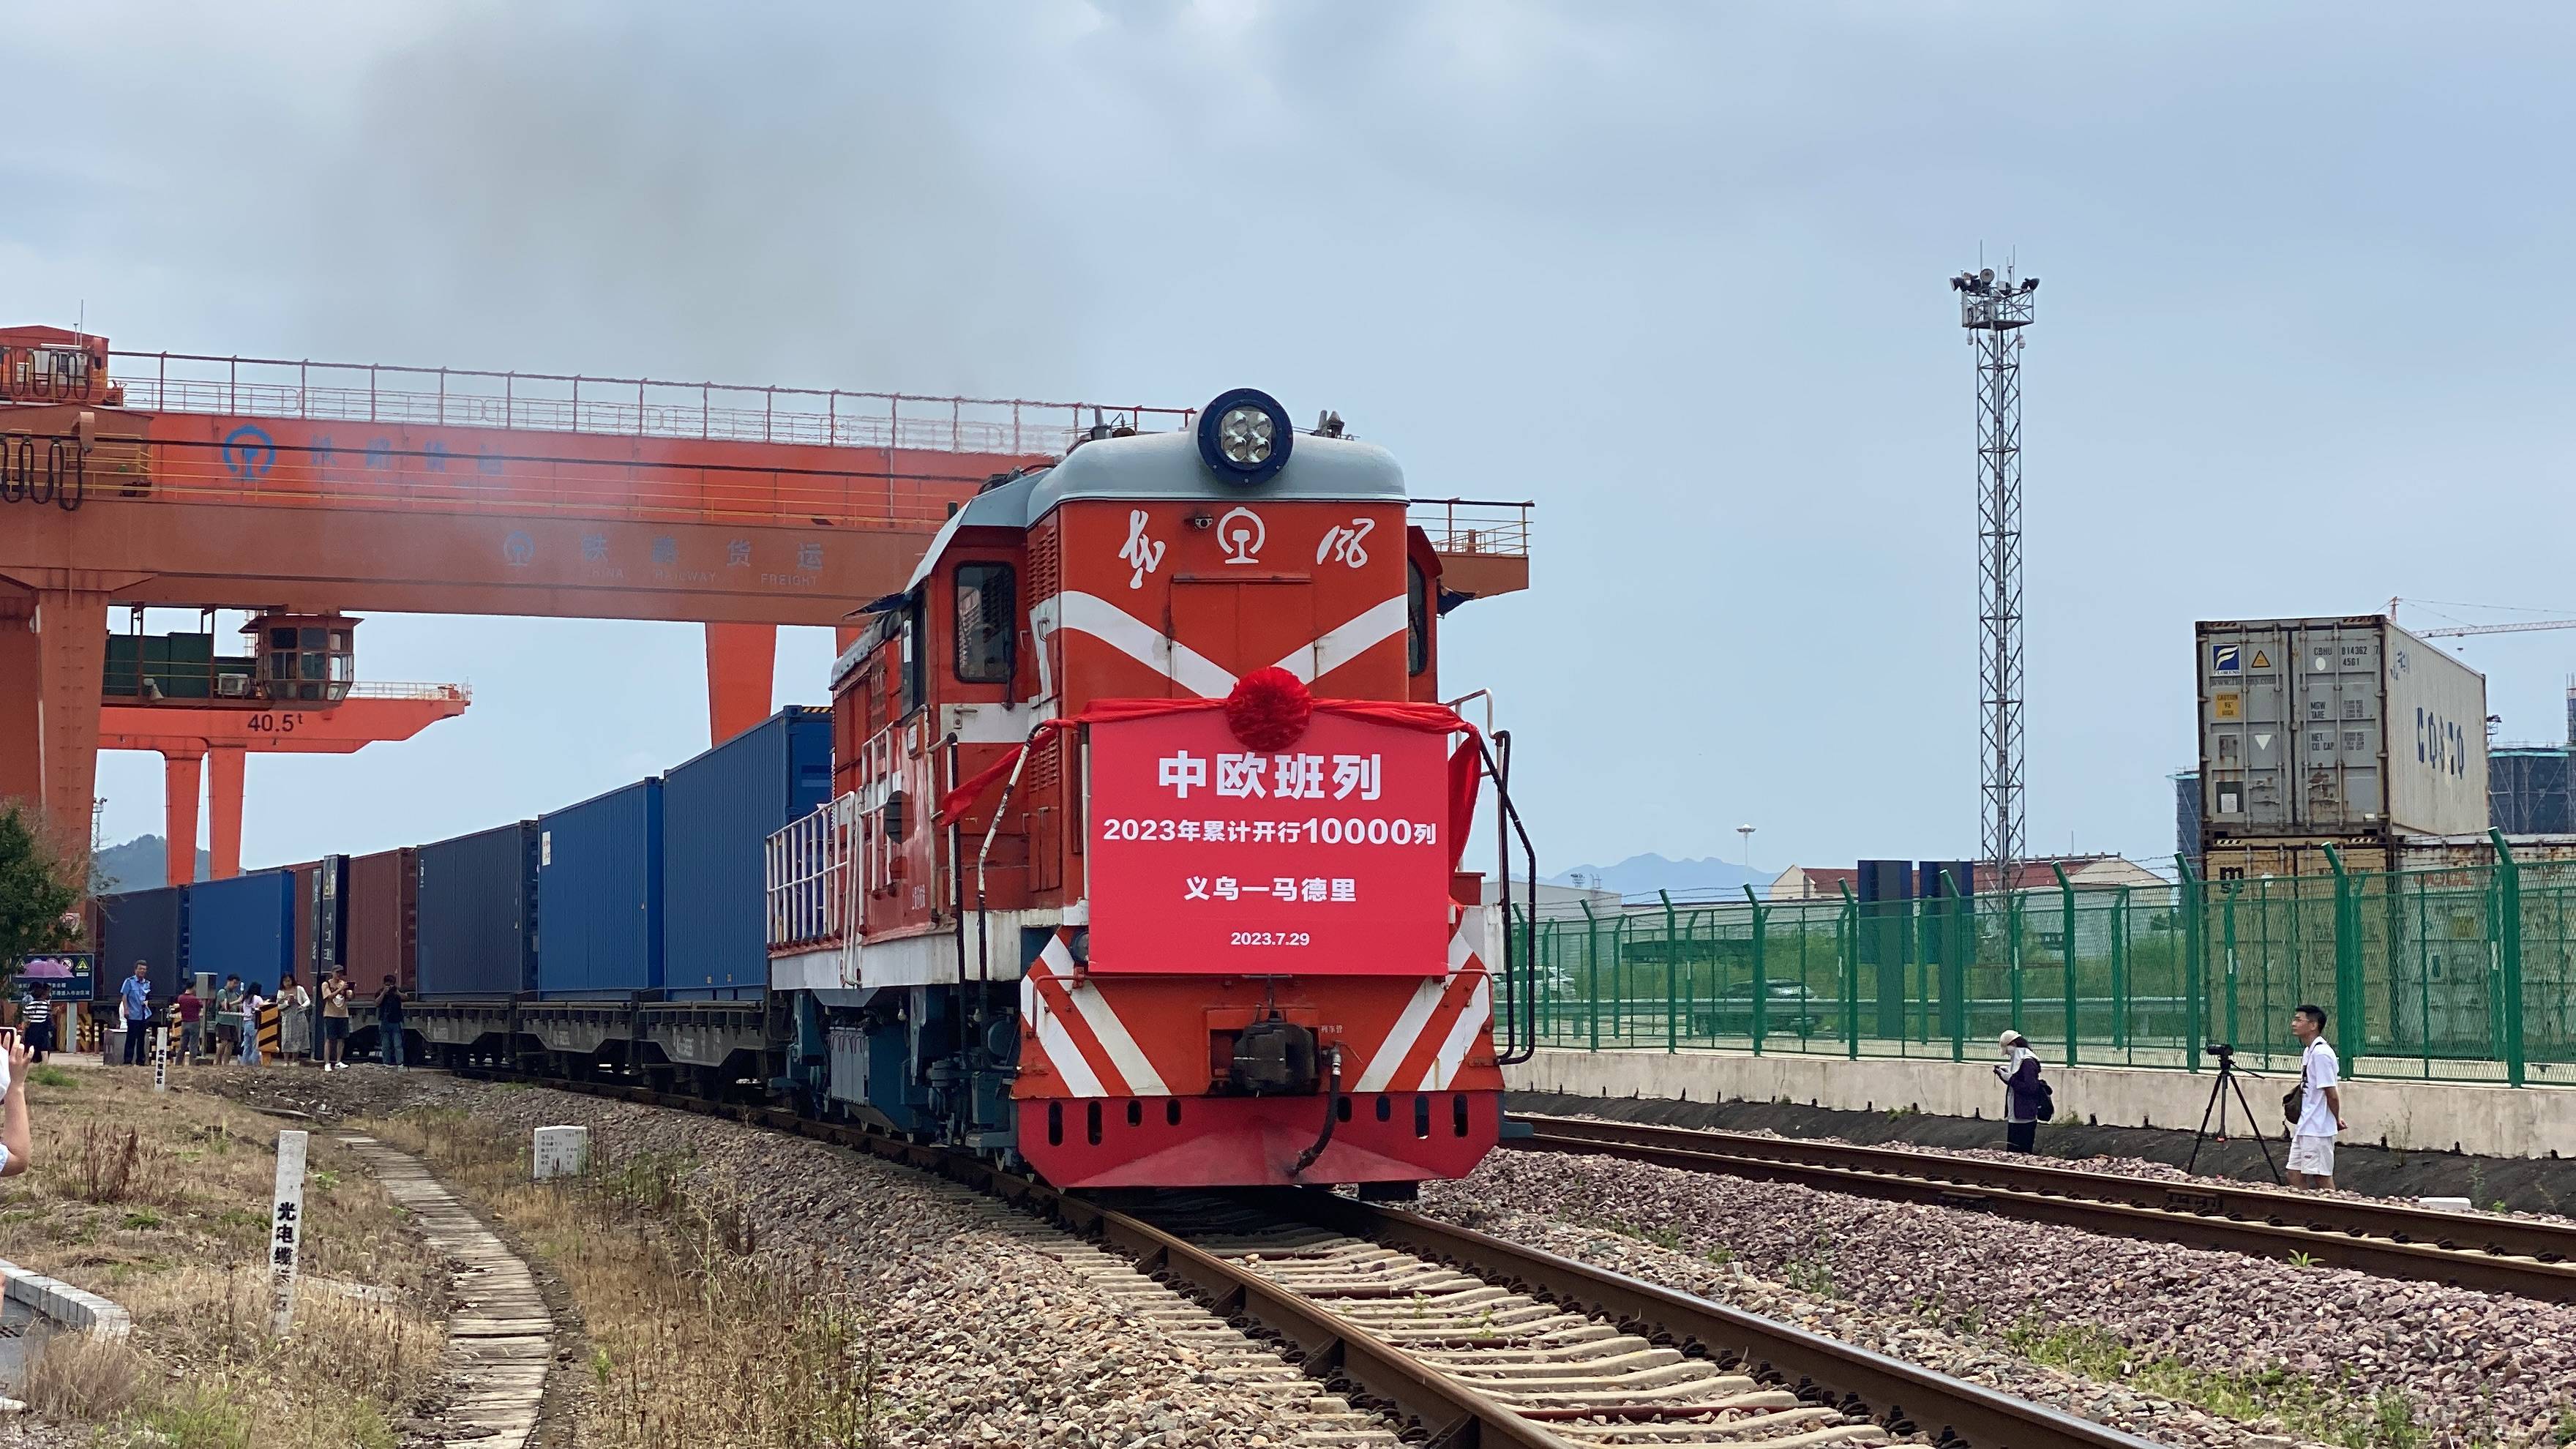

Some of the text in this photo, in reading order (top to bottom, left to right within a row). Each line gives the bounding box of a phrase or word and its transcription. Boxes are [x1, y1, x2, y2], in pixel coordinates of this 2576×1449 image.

[761, 573, 817, 586] FREIGHT
[2211, 677, 2277, 686] www.floens.com
[1158, 750, 1381, 801] 中欧班列
[1103, 817, 1437, 845] 2023年累计开行10000列
[1231, 932, 1310, 946] 2023.7.29
